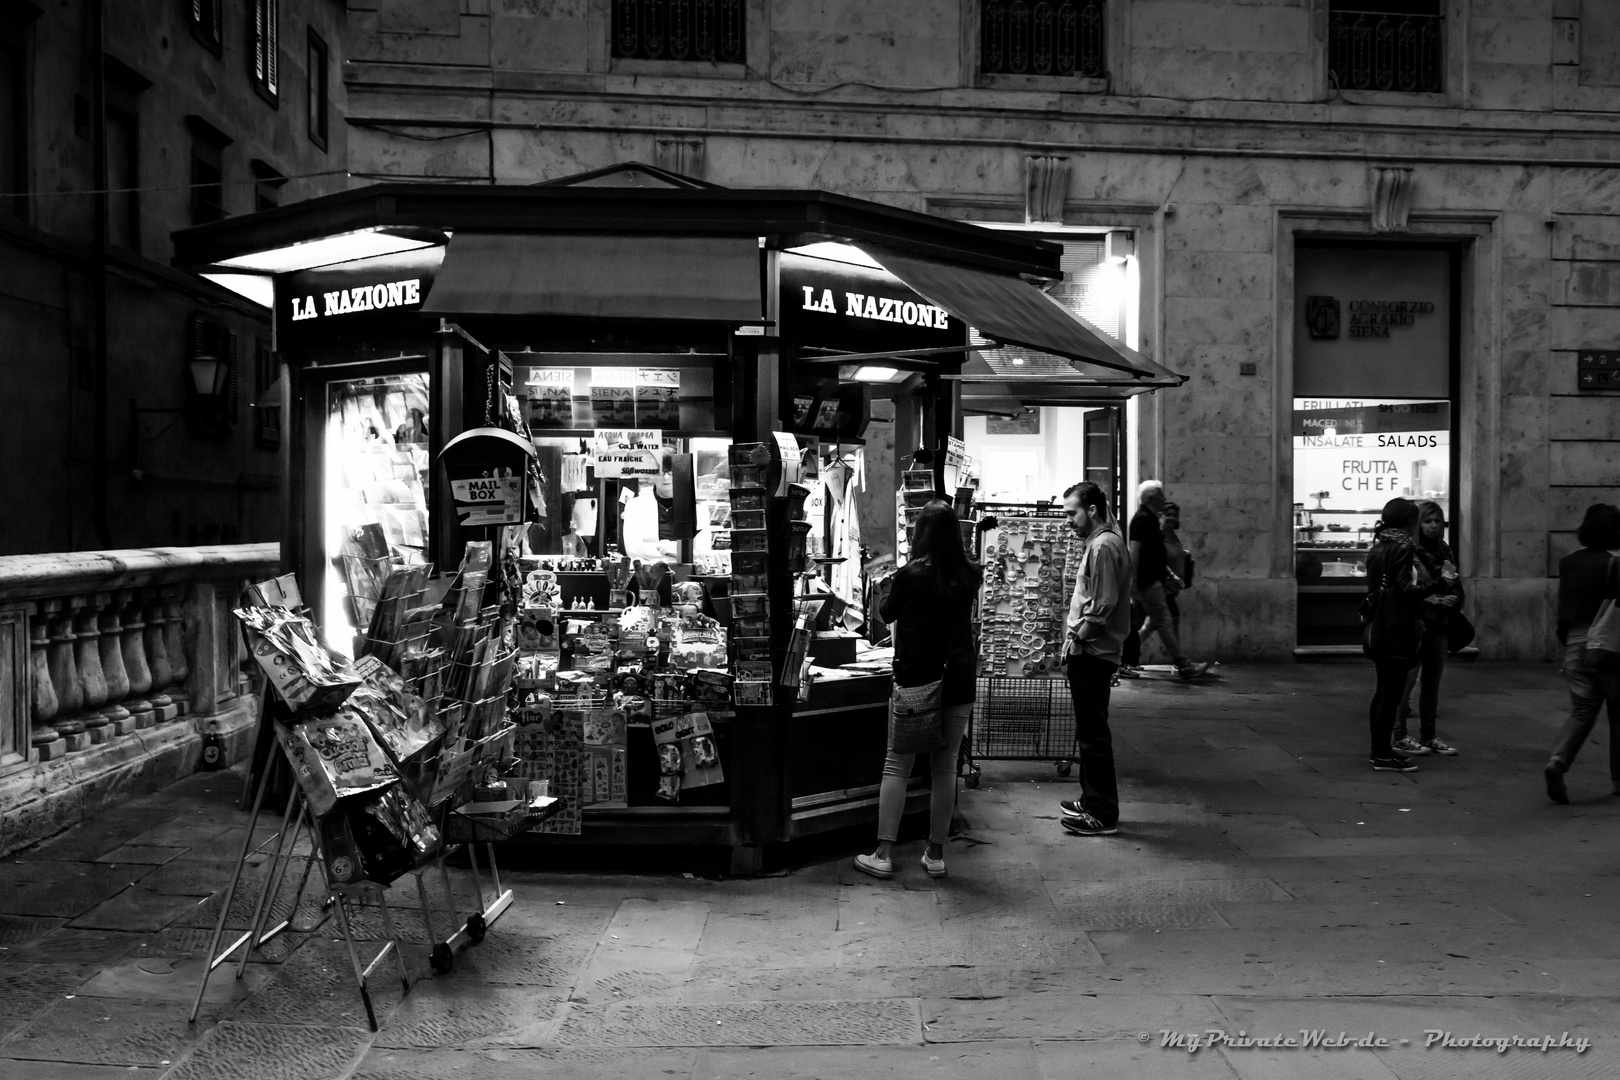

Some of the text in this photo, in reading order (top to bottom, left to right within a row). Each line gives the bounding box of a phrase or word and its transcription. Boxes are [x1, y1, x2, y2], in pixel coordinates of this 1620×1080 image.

[291, 279, 421, 321] LA NAZIONE
[802, 285, 949, 330] LA NAZIONE
[1349, 300, 1435, 314] CONSORZIO
[1349, 313, 1415, 326] AGRARIO
[1349, 326, 1390, 338] SIENA
[591, 388, 631, 396] SIENA
[1303, 436, 1363, 447] INSALATE
[1378, 435, 1437, 447] SALADS
[1342, 460, 1398, 474] FRUTTA
[468, 480, 501, 491] MAIL
[1342, 477, 1399, 491] CHEF
[469, 490, 496, 500] BOX
